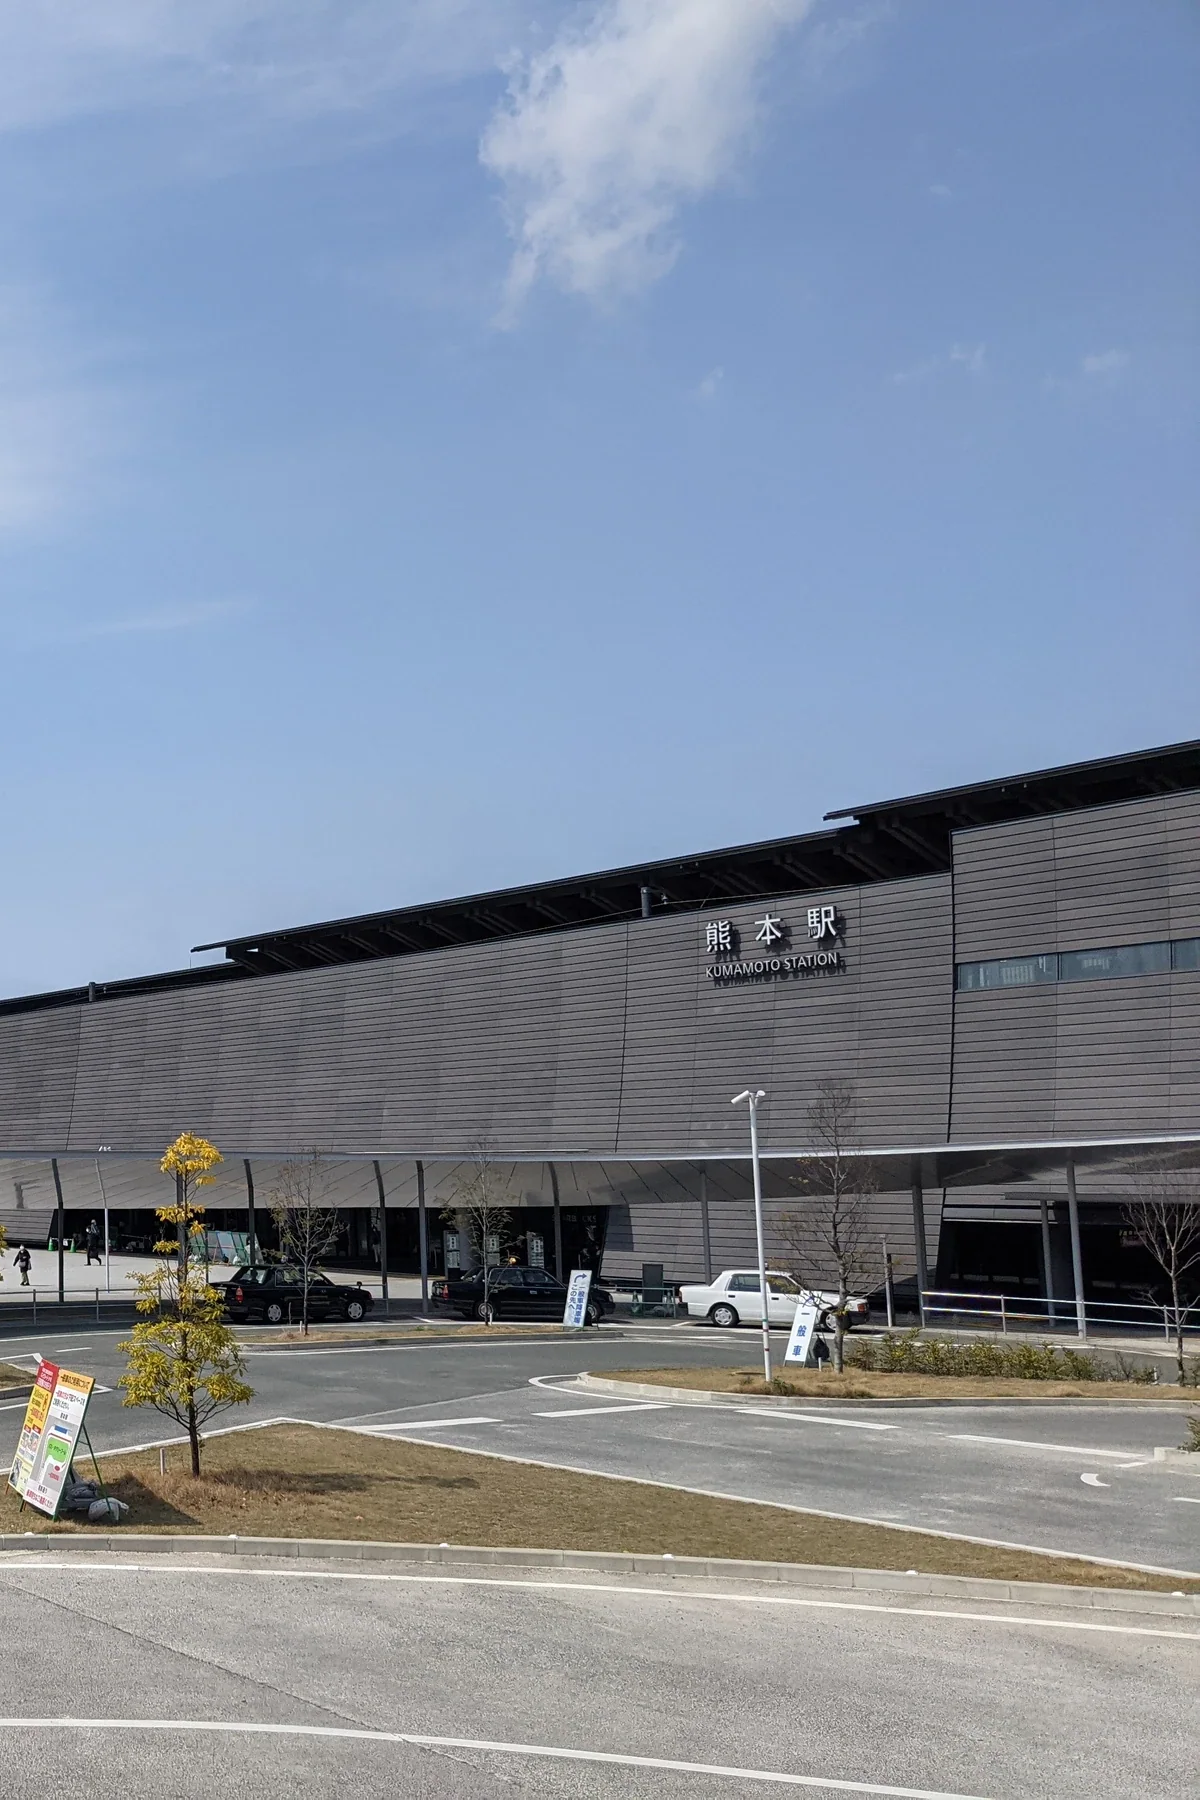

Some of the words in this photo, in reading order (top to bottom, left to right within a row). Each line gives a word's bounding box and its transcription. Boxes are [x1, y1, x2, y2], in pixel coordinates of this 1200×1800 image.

[705, 905, 837, 953] 熊本駅
[705, 959, 781, 978] KUMAMOTO
[784, 952, 837, 970] STATION
[792, 1312, 810, 1357] 一般車
